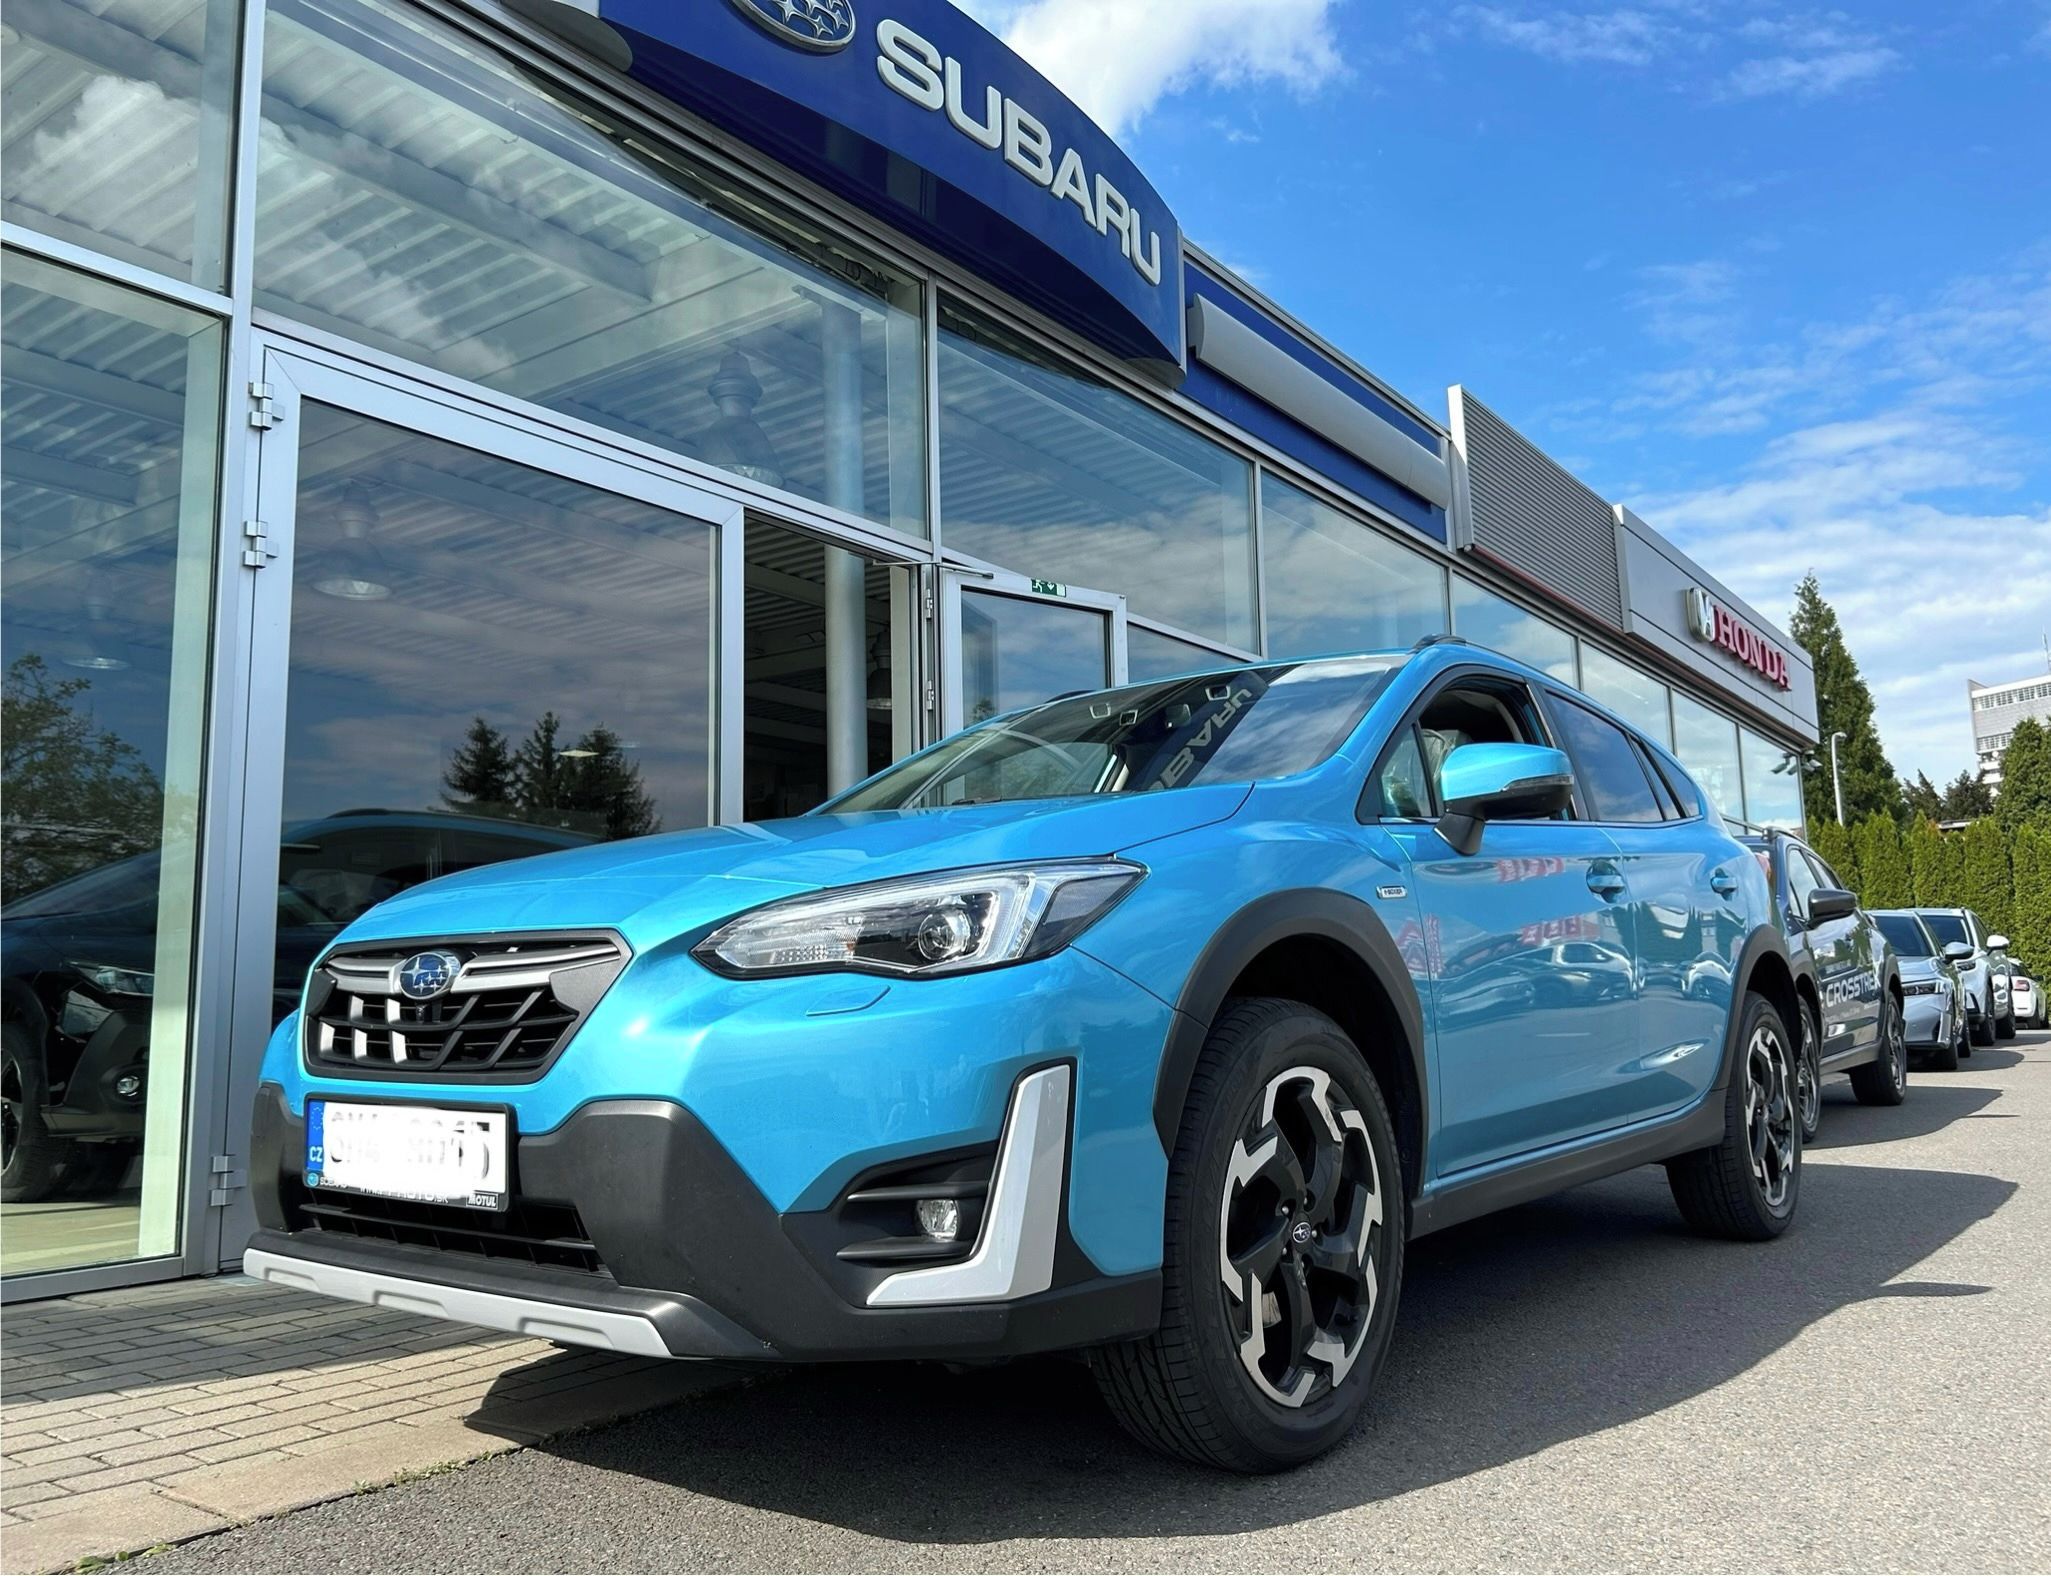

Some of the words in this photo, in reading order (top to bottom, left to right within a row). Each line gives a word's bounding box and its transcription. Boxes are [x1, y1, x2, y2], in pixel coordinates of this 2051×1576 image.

[877, 18, 1161, 286] SUBARU
[1712, 606, 1792, 691] HONDA
[1826, 971, 1882, 1008] CROSSTREK
[309, 1146, 323, 1162] CZ
[468, 1195, 497, 1208] MOTUL
